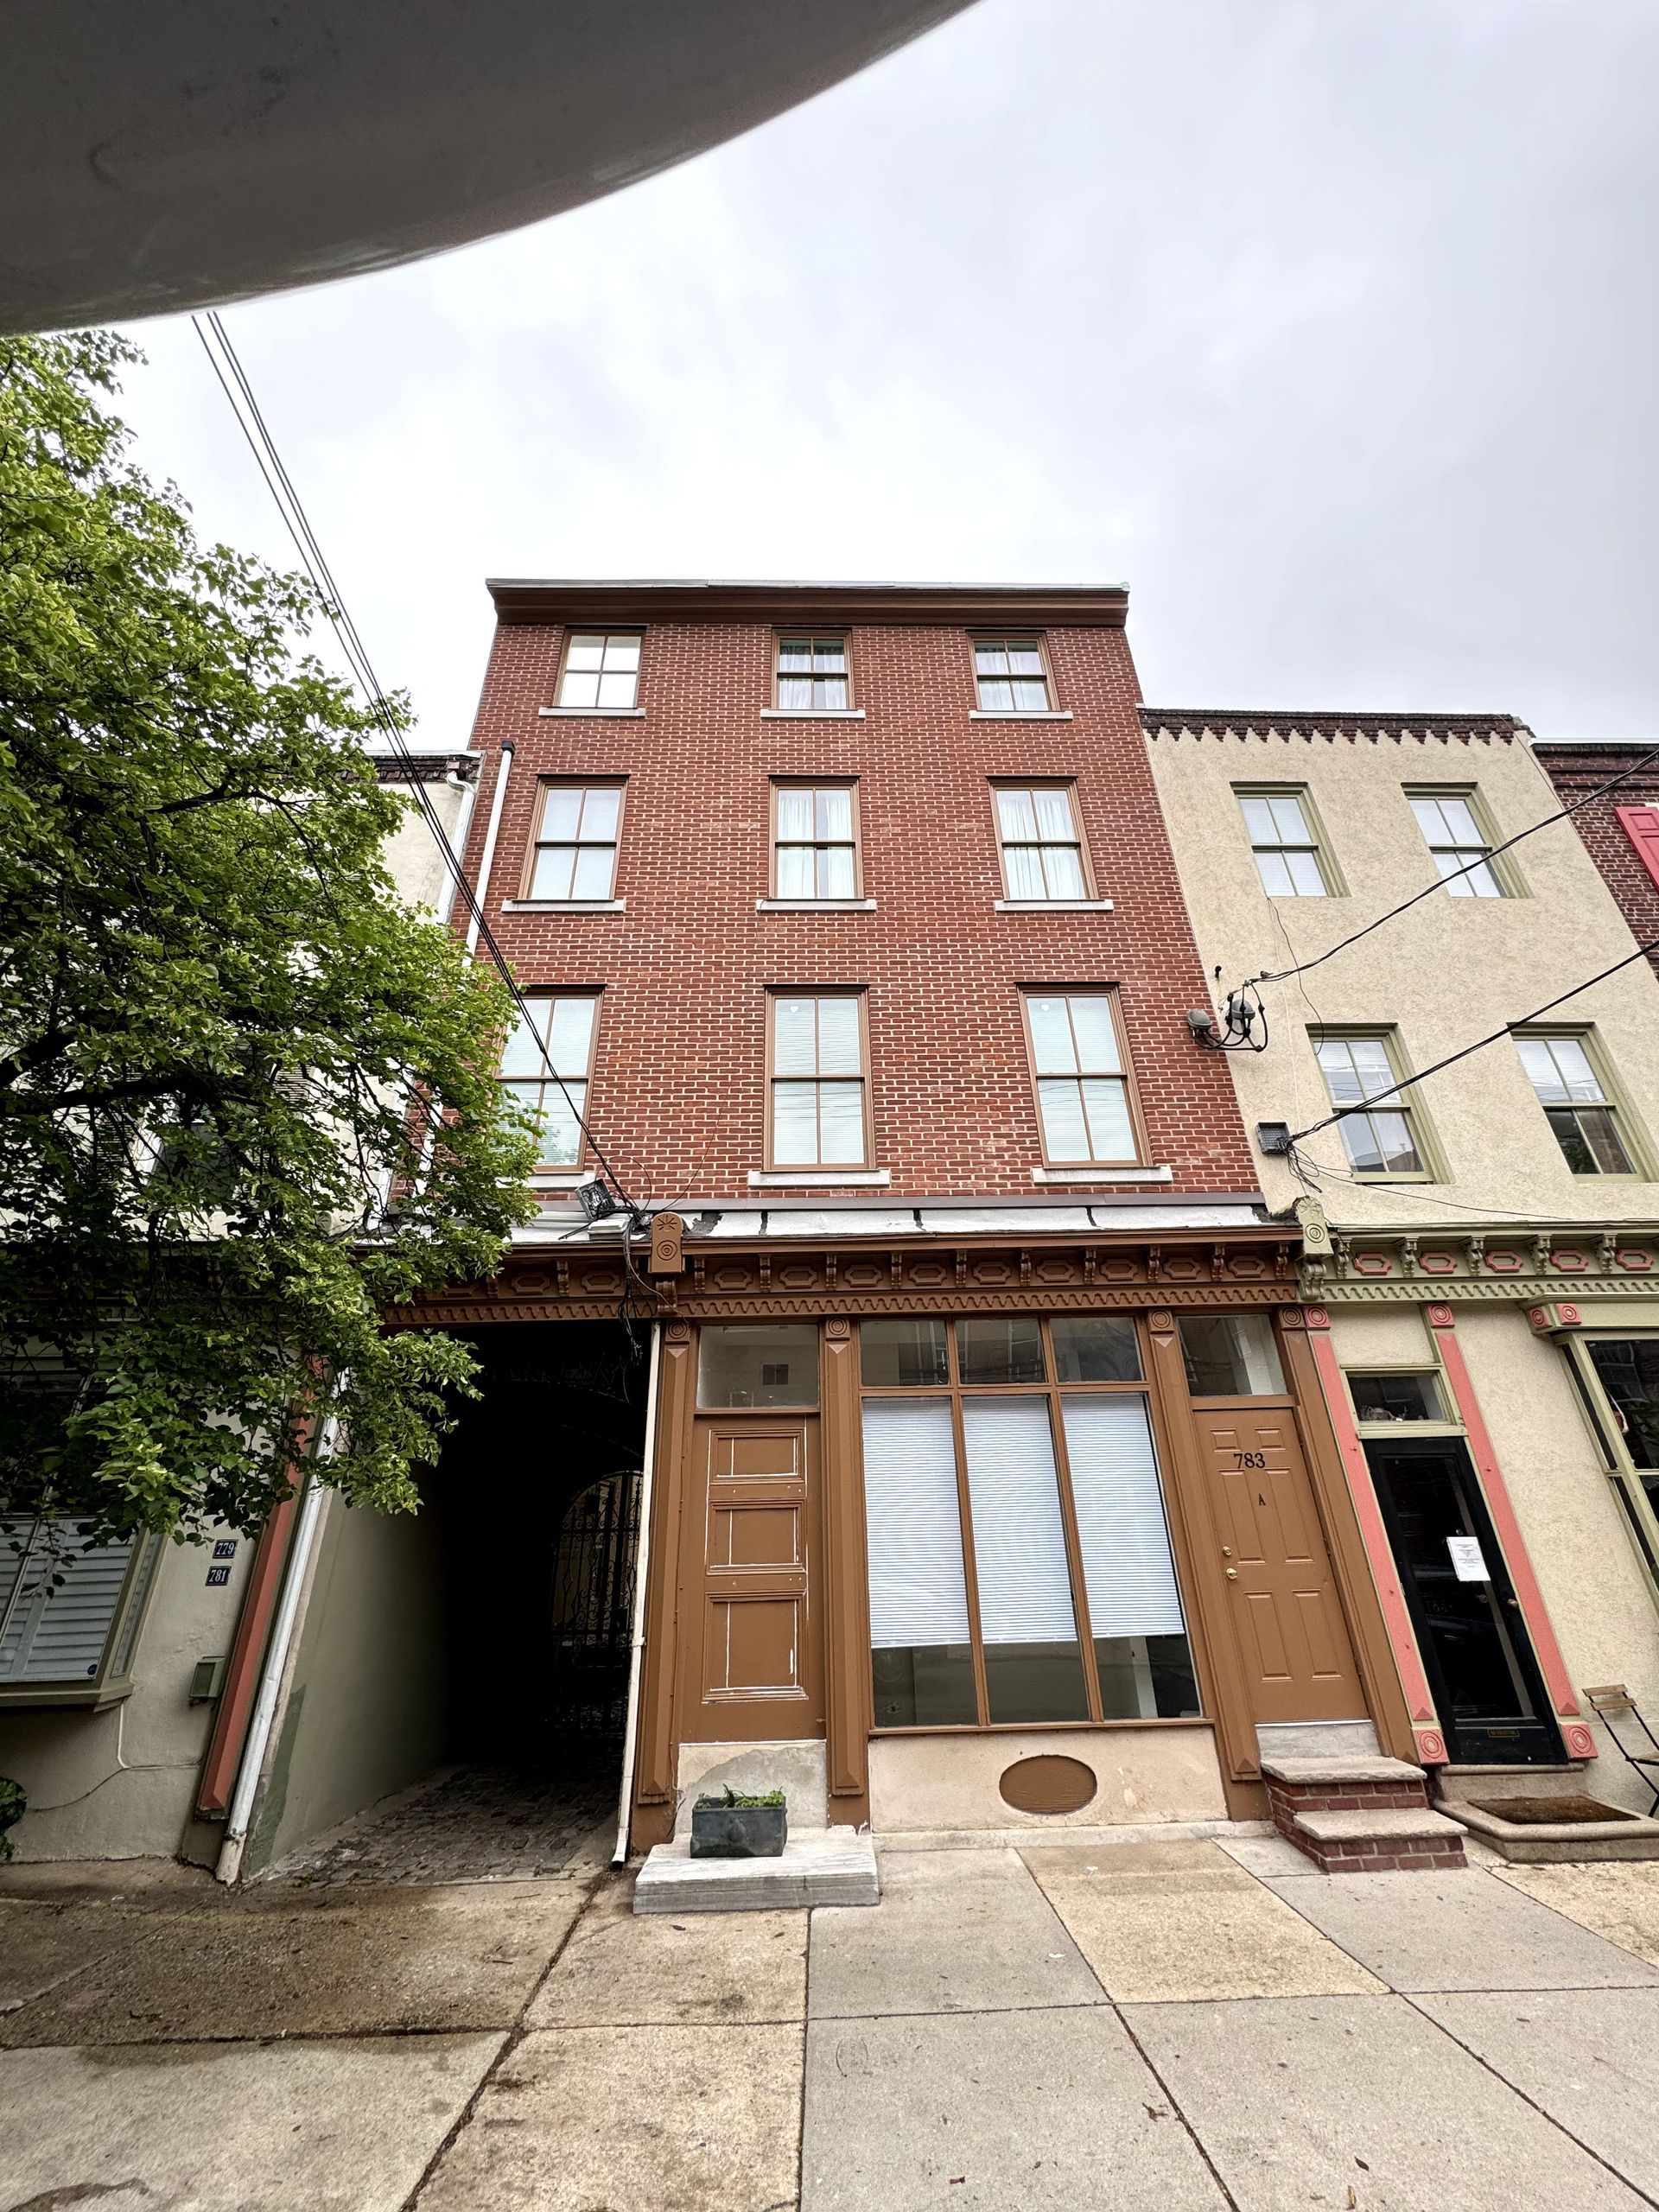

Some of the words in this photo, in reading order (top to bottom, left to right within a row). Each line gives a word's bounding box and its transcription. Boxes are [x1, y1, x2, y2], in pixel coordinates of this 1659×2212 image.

[1233, 1452, 1266, 1469] 783
[1258, 1493, 1266, 1505] A
[216, 1542, 234, 1555] 779
[208, 1569, 226, 1582] 781
